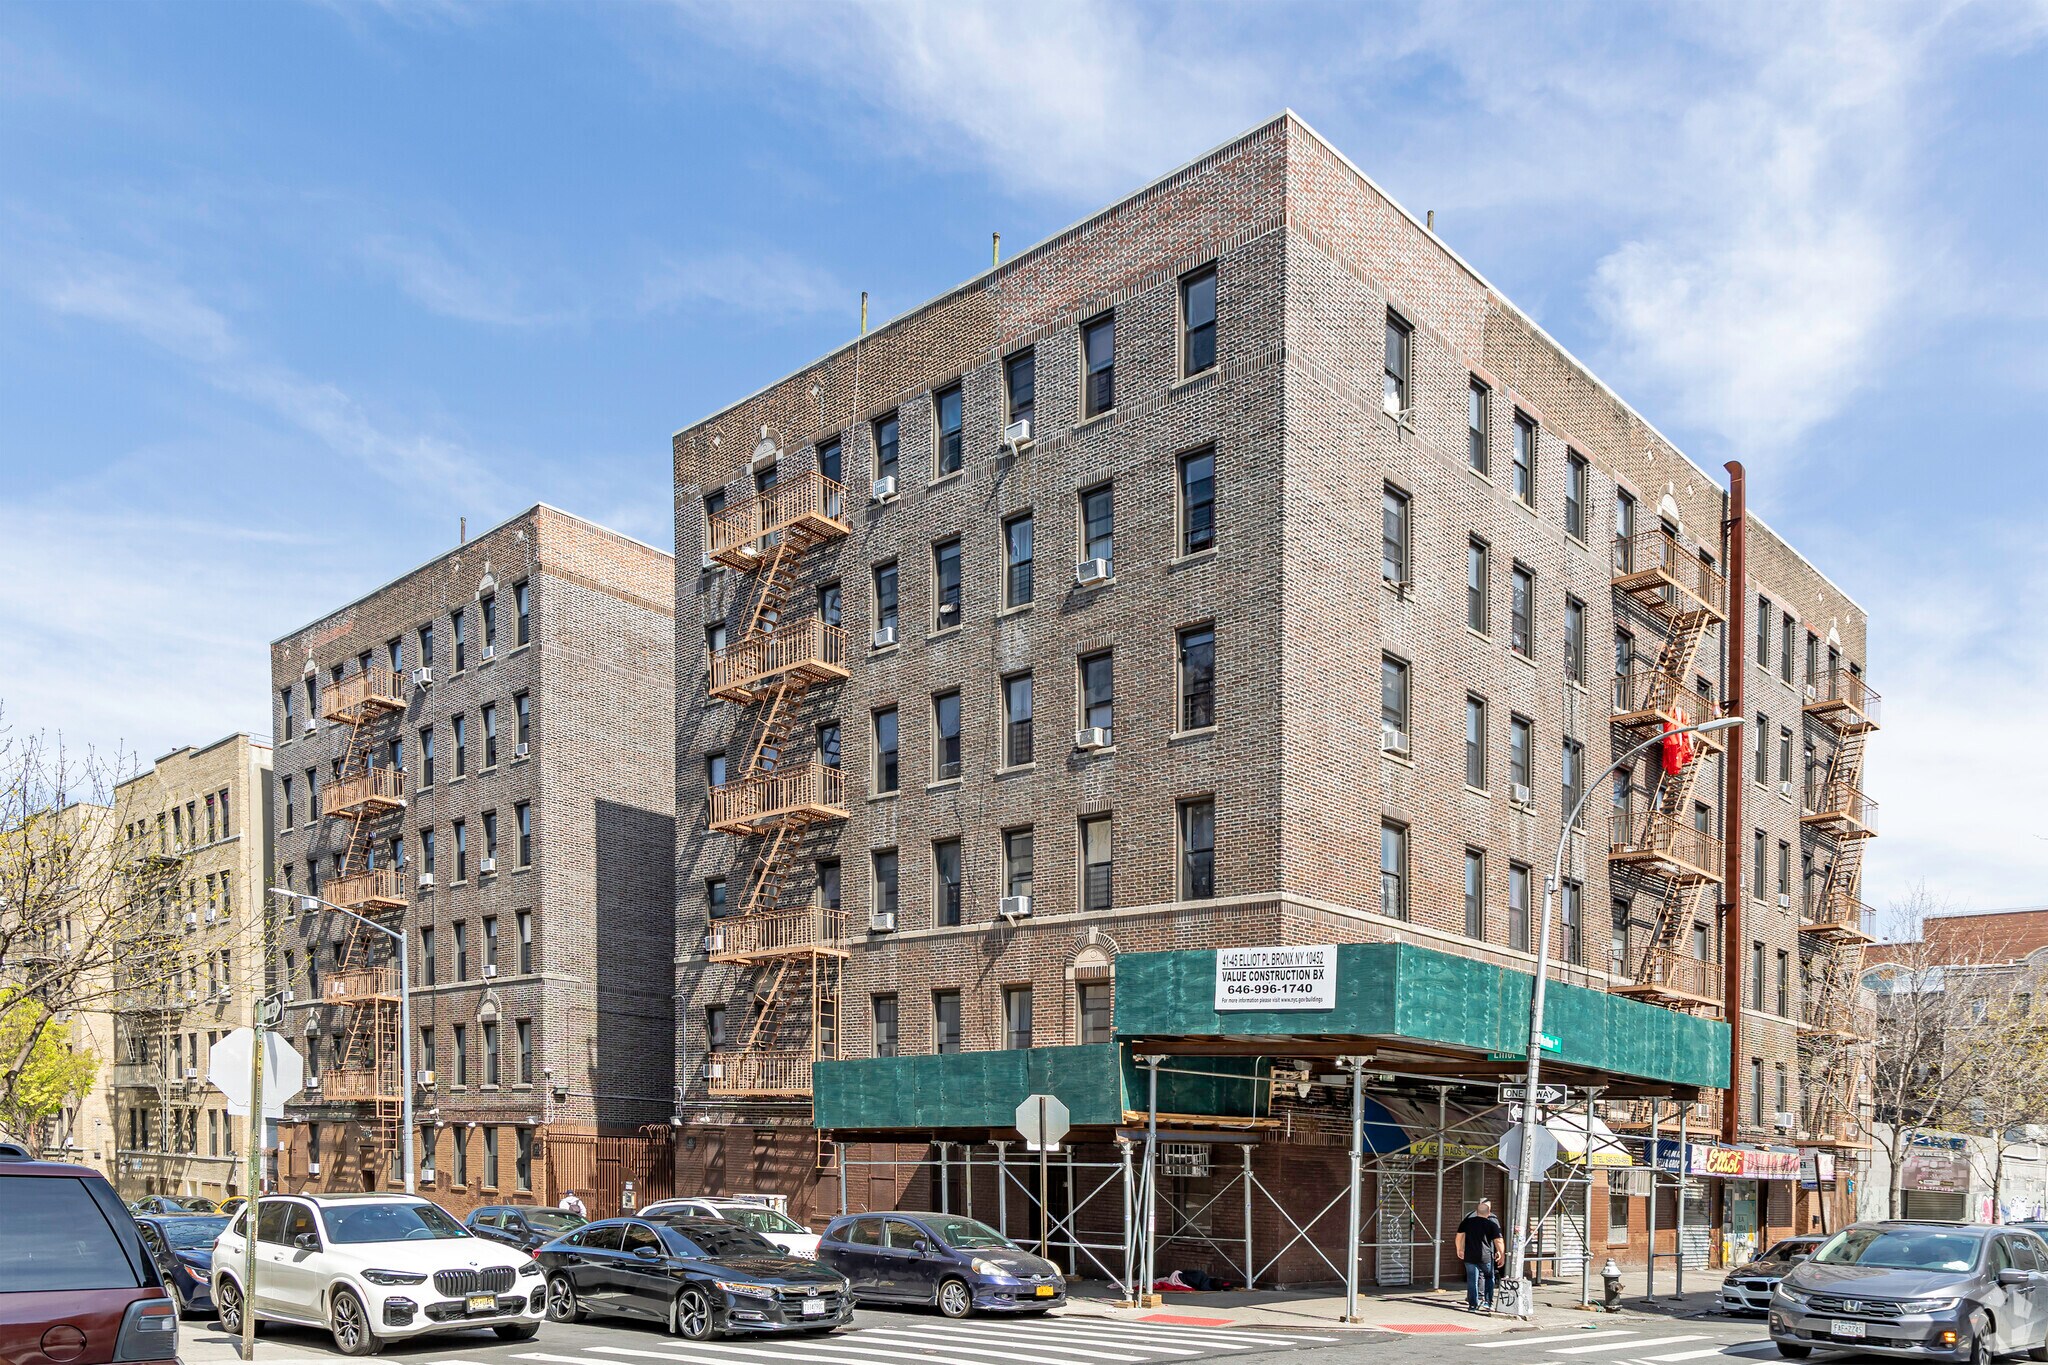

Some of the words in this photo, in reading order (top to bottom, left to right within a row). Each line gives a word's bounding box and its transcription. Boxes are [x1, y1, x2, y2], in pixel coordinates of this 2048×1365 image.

[1222, 954, 1238, 967] 41-45
[1239, 953, 1261, 967] ELLIOT
[1262, 953, 1270, 966] PL
[1271, 952, 1294, 966] BRONX
[1295, 951, 1305, 965] NY
[1306, 951, 1324, 964] 10452
[1222, 971, 1247, 982] VALUE
[1248, 969, 1311, 982] CONSTRUCTION
[1313, 969, 1324, 980] BX
[1227, 983, 1313, 995] 646-996-1740
[1506, 1089, 1524, 1098] ONE
[1536, 1090, 1554, 1099] WAY
[1706, 1148, 1743, 1173] Elliot
